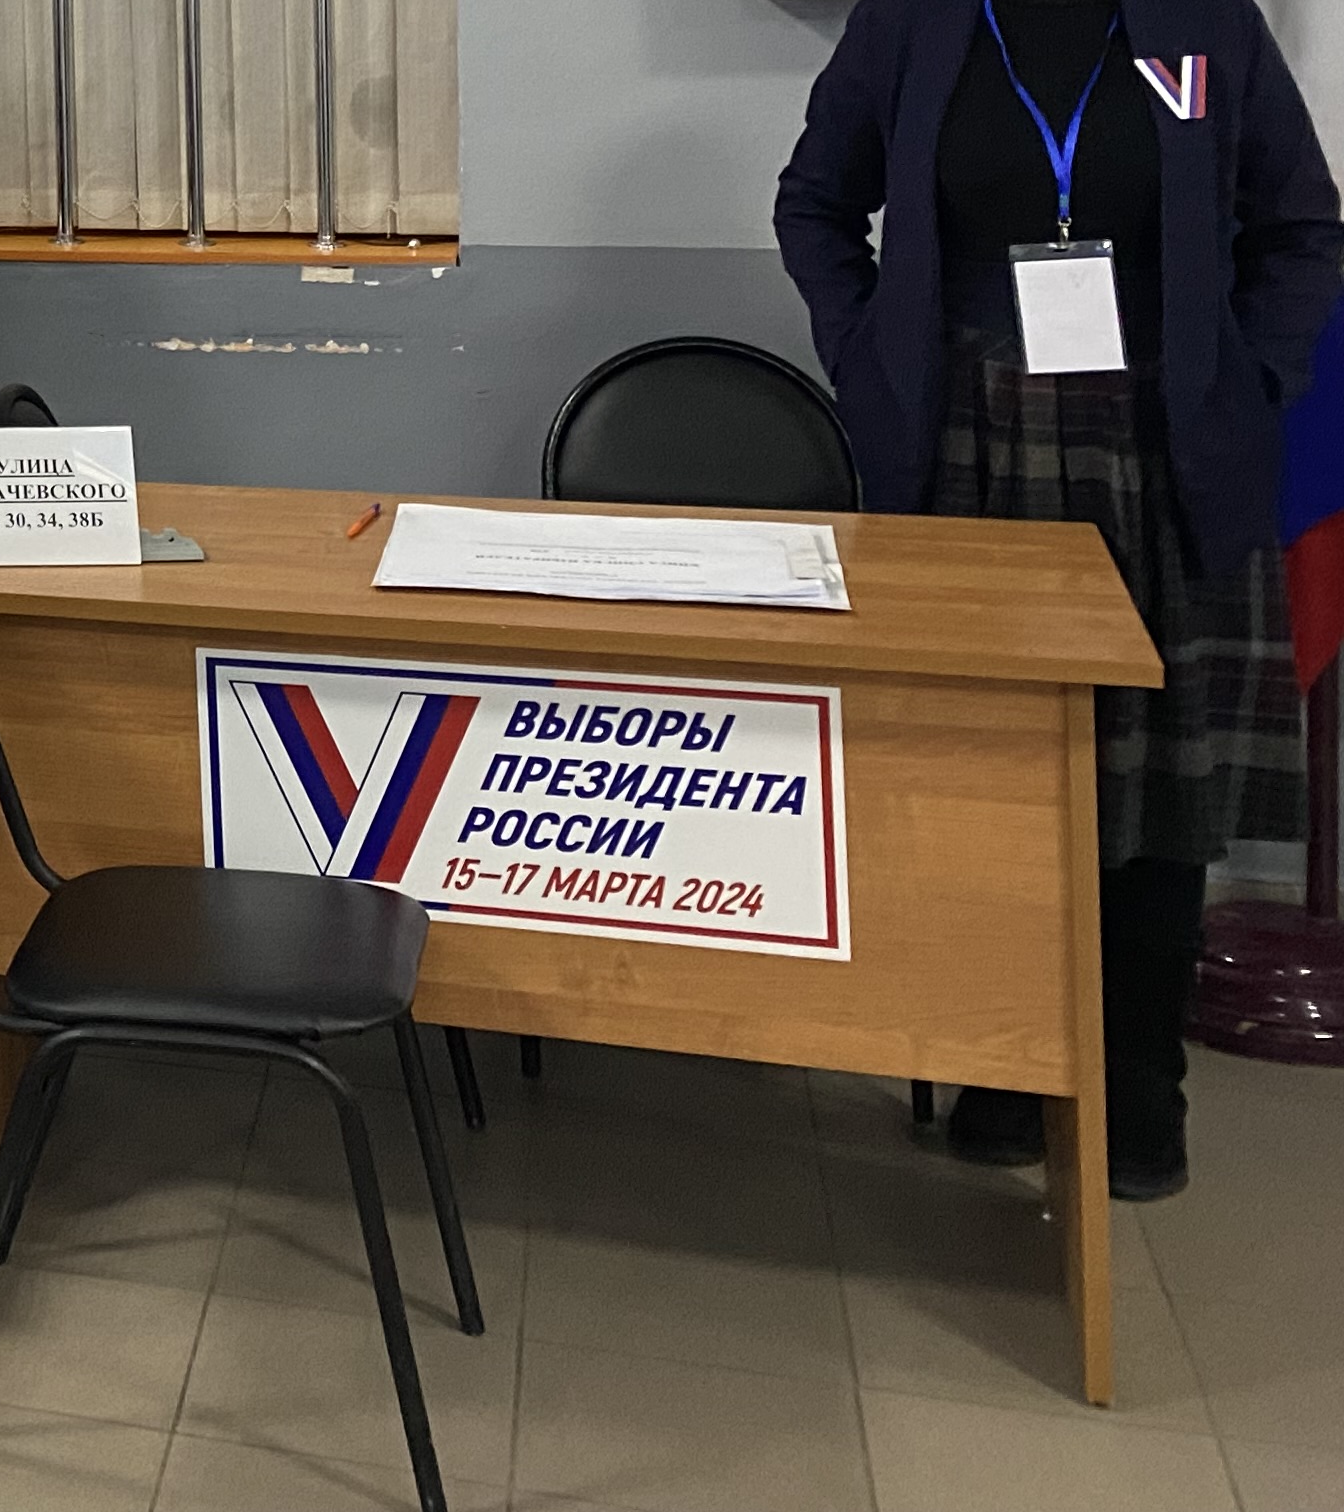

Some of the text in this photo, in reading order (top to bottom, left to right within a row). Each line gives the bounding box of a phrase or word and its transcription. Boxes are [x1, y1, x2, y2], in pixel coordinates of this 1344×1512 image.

[5, 513, 32, 530] 30,
[37, 513, 63, 530] 34,
[68, 512, 104, 528] 38Б
[504, 700, 735, 753] ВЫБОРЫ
[481, 753, 808, 816] ПРЕЗИДЕНТА
[458, 806, 665, 860] РОССИИ
[543, 867, 666, 910] МАРТА
[674, 878, 765, 918] 2024
